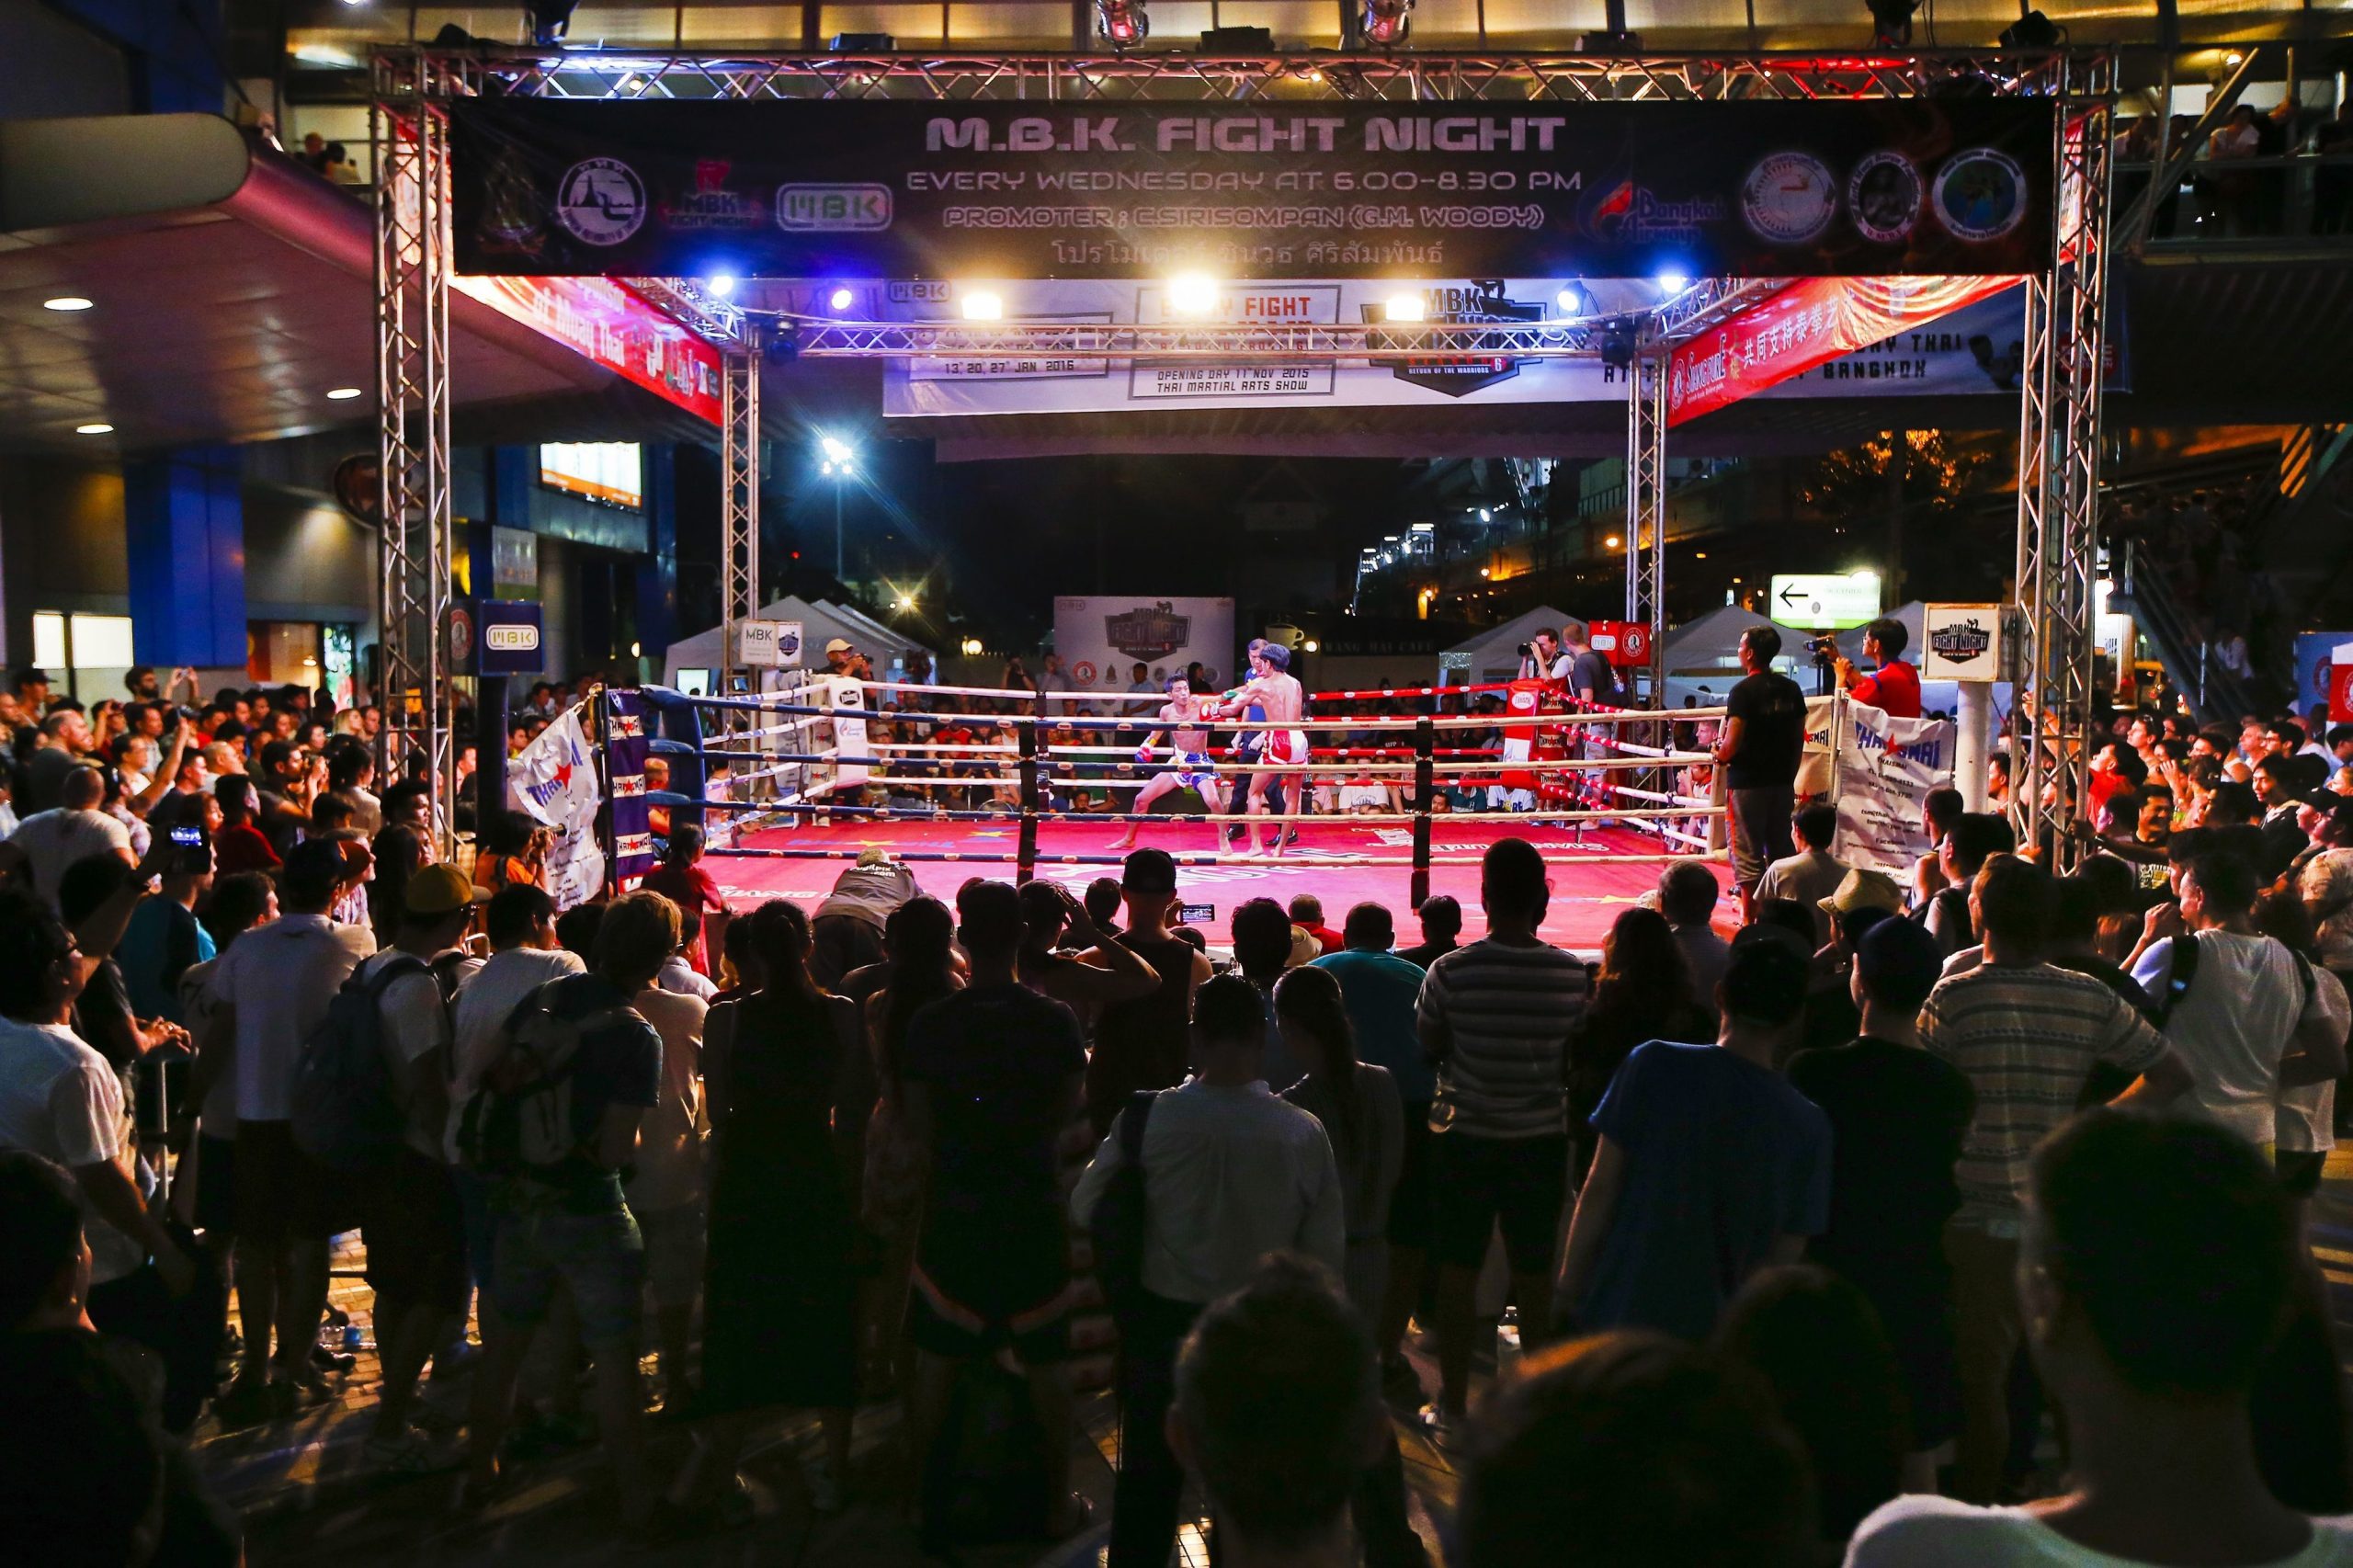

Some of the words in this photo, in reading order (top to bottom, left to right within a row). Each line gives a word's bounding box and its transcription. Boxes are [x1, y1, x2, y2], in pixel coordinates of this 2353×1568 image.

[926, 117, 1136, 152] M.B.K.
[1157, 117, 1345, 152] FIGHT
[1365, 117, 1566, 152] NIGHT
[906, 171, 1026, 191] EVERY
[1037, 171, 1264, 191] WEDNESDAY
[1276, 171, 1324, 191] AT
[1334, 171, 1516, 191] 6.00-8.30
[1529, 171, 1581, 191] PM
[788, 194, 880, 220] MBK
[943, 207, 1113, 229] PROMOTER
[1420, 205, 1545, 230] WOODY)
[1245, 296, 1312, 317] FIGHT
[1424, 288, 1484, 314] MBK
[1911, 333, 1961, 352] THAI
[1015, 361, 1038, 373] JAN
[1045, 359, 1074, 372] 2016
[1408, 367, 1431, 375] RETURN
[1434, 367, 1442, 375] OF
[1444, 367, 1455, 375] THE
[1494, 358, 1503, 372] 6
[1823, 359, 1927, 380] BANGKOK
[1157, 369, 1203, 381] OPENING
[1209, 368, 1231, 380] DAY
[1253, 368, 1274, 379] NOV
[1282, 368, 1310, 379] 2015
[1157, 382, 1182, 393] THAI
[1187, 381, 1236, 392] MARTIAL
[1241, 381, 1270, 392] ARTS
[1275, 381, 1308, 391] SHOW
[745, 629, 772, 642] MBK
[1949, 624, 1970, 633] MBK
[493, 631, 531, 643] MBK
[1933, 633, 1958, 649] FIGHT
[1959, 633, 1987, 649] NIGHT
[850, 863, 892, 872] ugilpix
